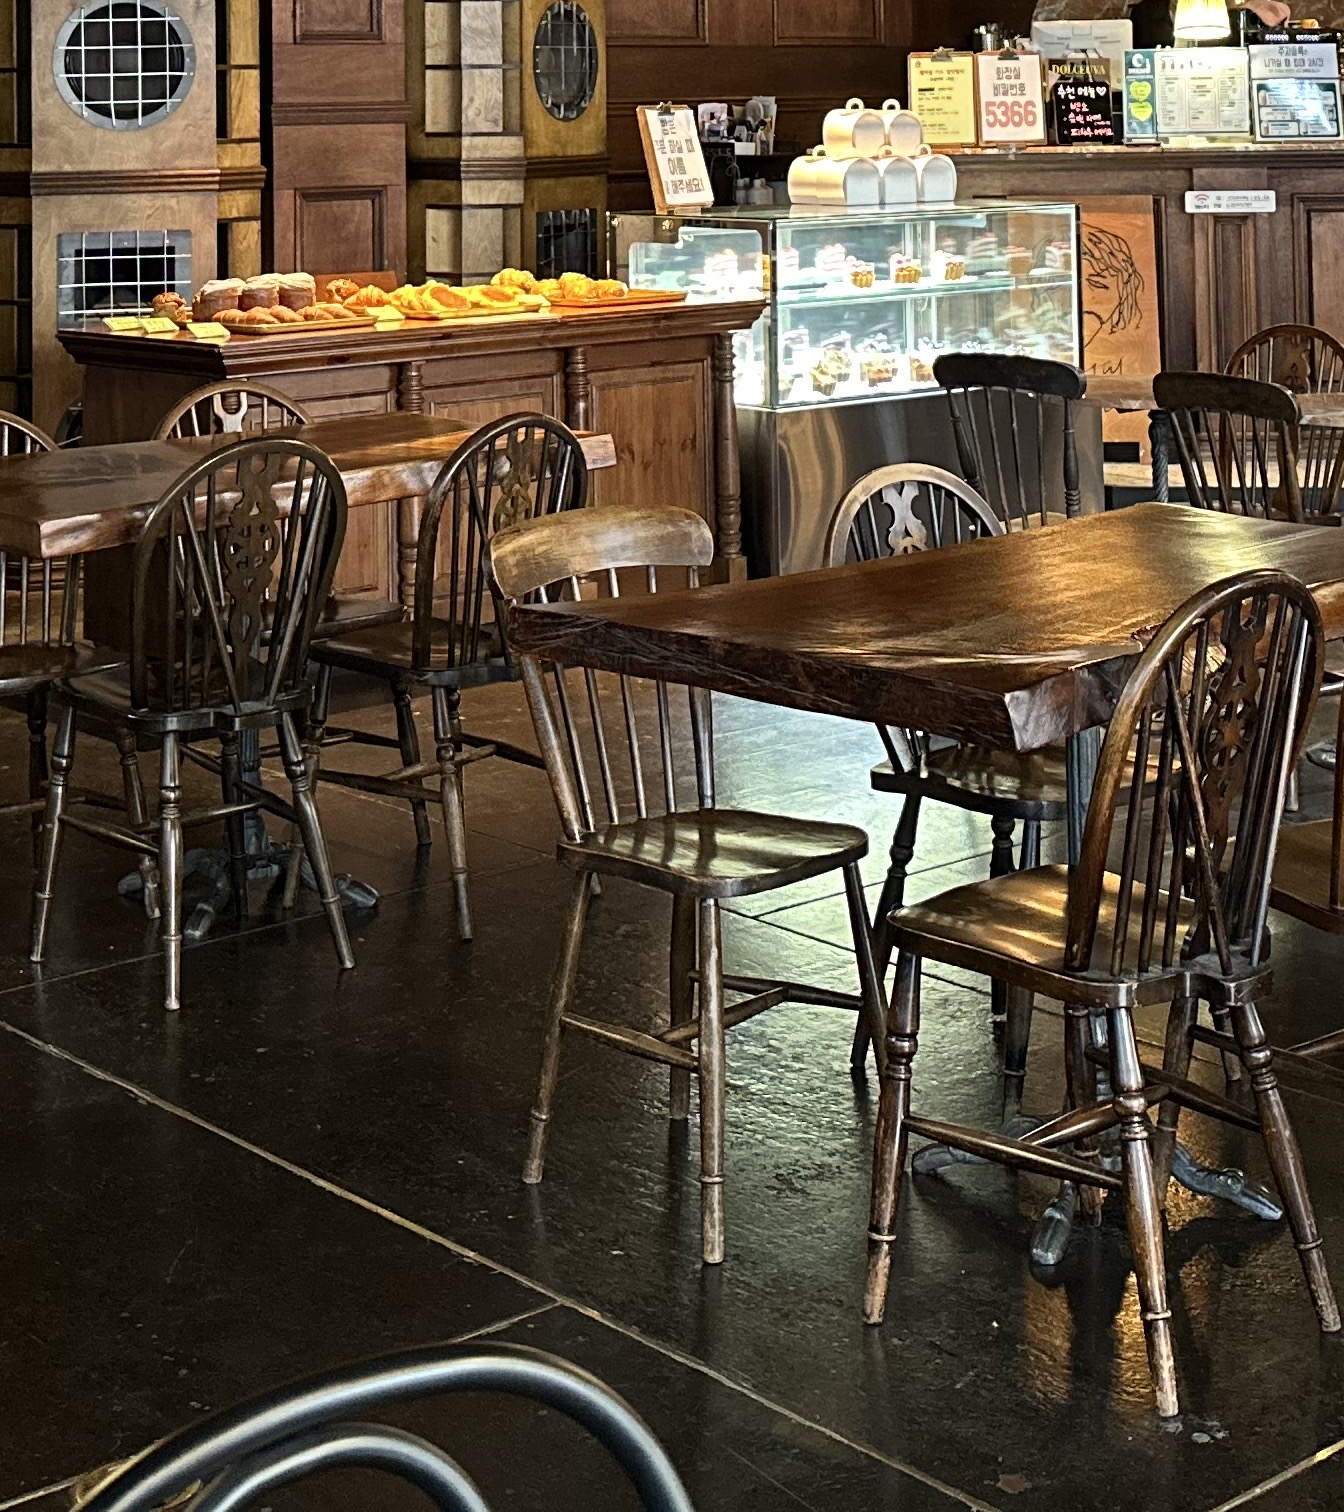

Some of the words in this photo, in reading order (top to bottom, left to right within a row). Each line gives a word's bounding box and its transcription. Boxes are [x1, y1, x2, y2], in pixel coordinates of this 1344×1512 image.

[996, 67, 1021, 80] 화장실
[993, 82, 1026, 97] 비밀번호
[1057, 83, 1076, 99] 추천
[1077, 85, 1096, 99] 메뉴
[984, 100, 1037, 128] 5366
